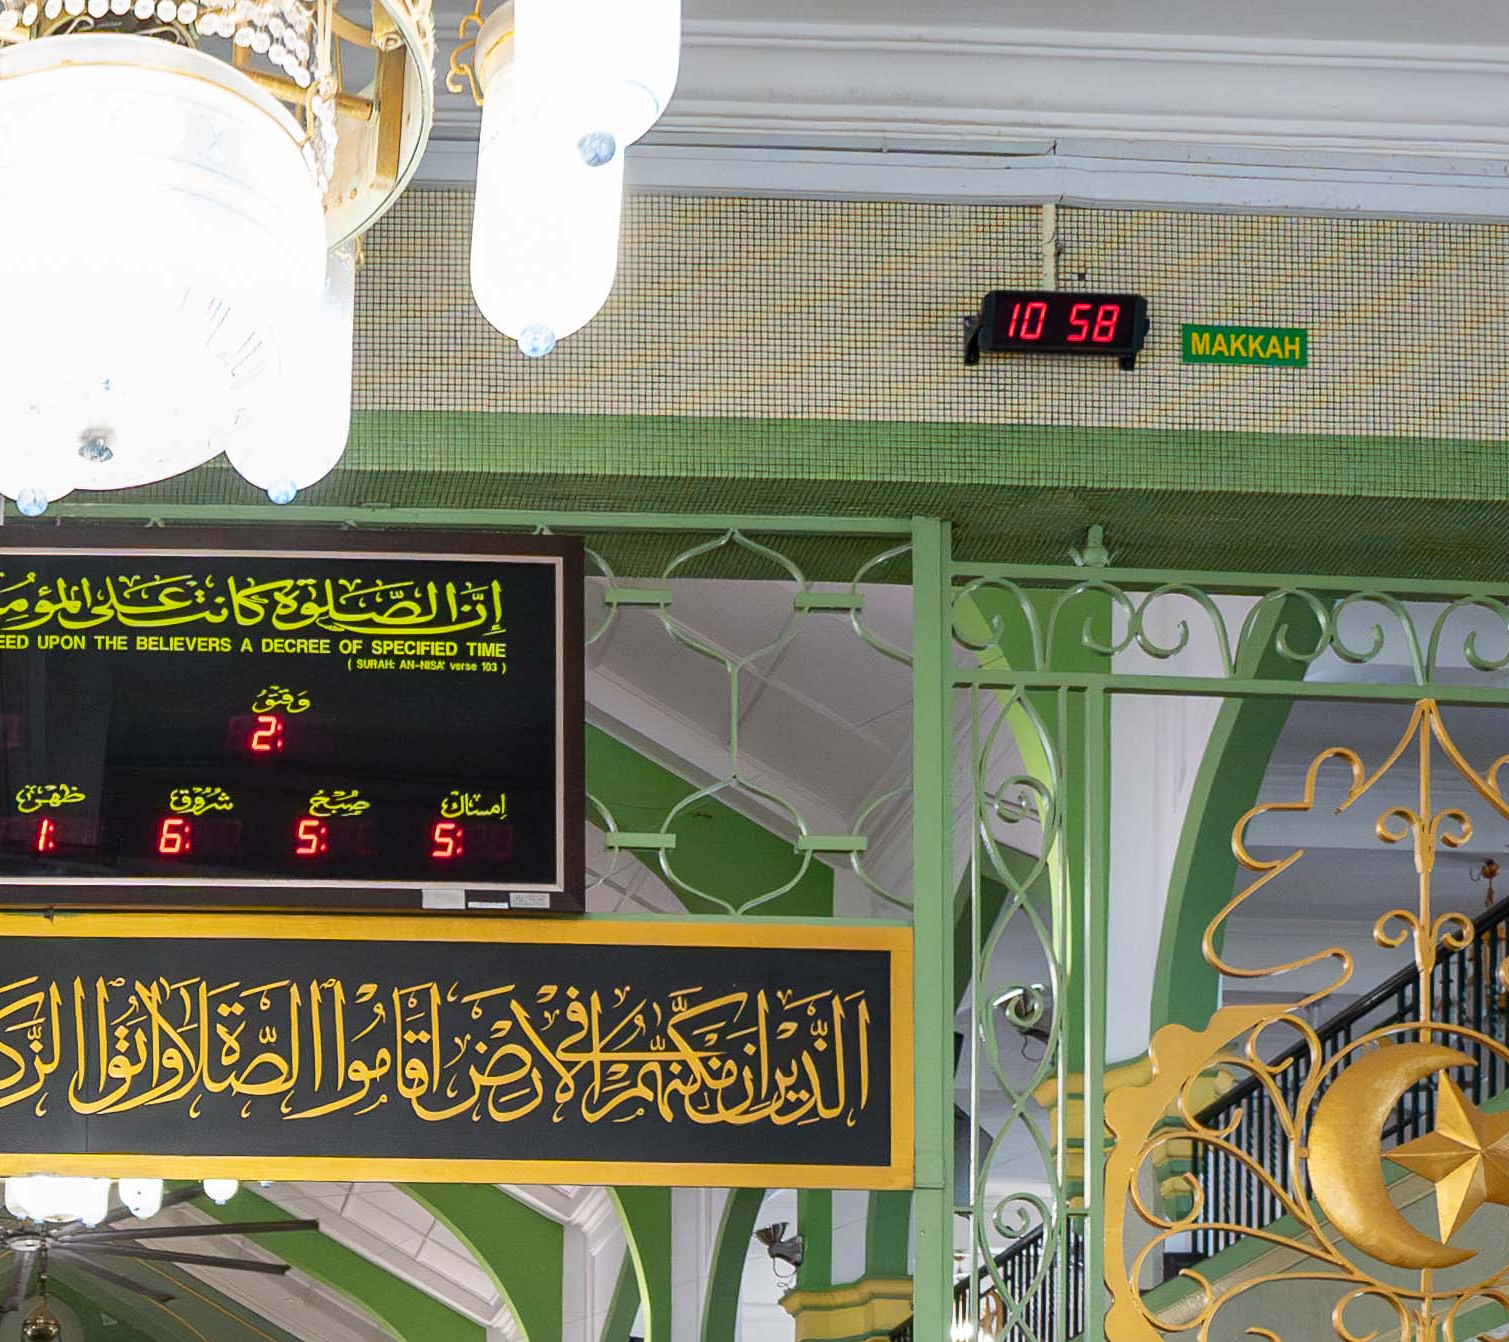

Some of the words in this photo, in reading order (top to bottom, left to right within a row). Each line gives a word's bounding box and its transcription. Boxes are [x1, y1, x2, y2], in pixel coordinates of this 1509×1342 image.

[1190, 331, 1301, 360] MAKKAH
[37, 634, 86, 650] UPON
[93, 635, 128, 651] THE
[135, 635, 232, 653] BELIEVERS
[240, 637, 253, 653] A
[261, 638, 331, 654] DECREE
[338, 639, 363, 655] OF
[371, 639, 458, 657] SPECIFIED
[465, 641, 507, 658] TIME
[449, 662, 477, 671] verse
[481, 661, 498, 672] 103
